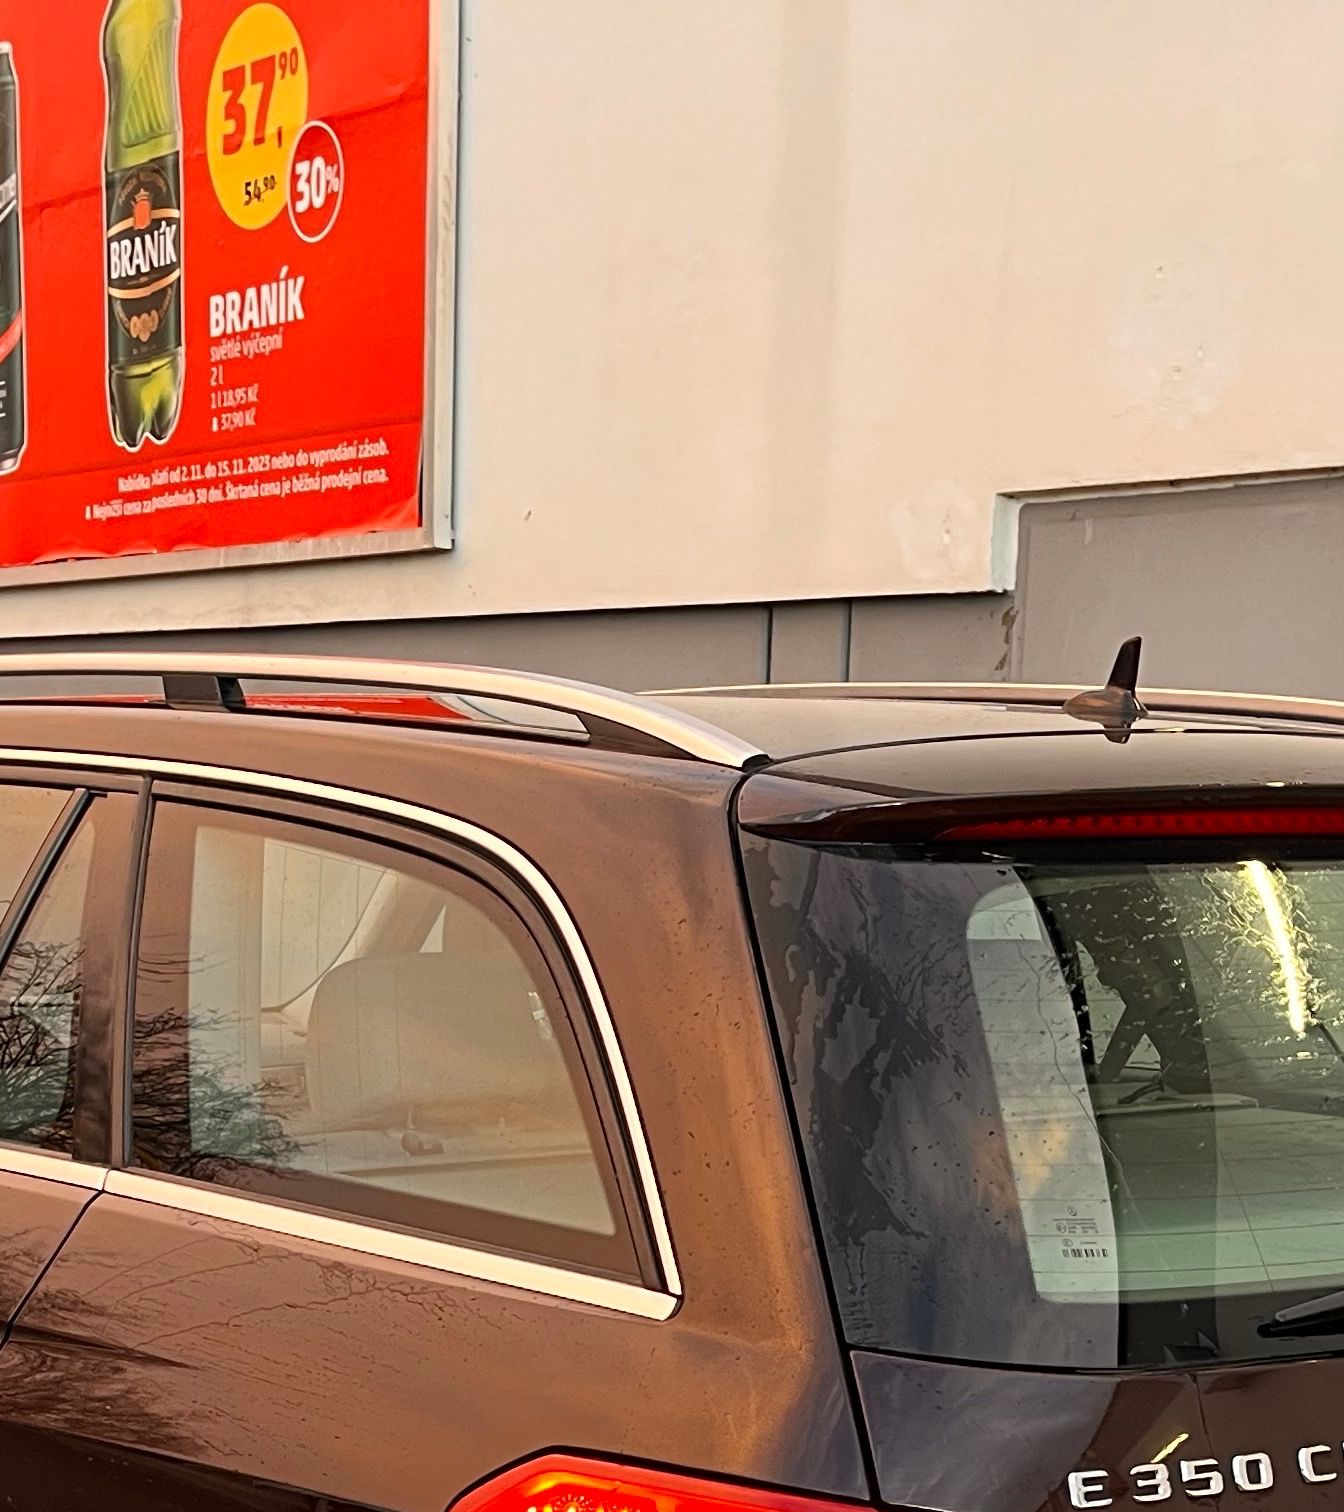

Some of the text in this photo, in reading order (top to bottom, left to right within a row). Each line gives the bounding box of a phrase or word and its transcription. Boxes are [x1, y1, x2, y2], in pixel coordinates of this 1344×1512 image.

[295, 156, 340, 213] 30%
[110, 220, 178, 280] BRANÍK
[209, 265, 305, 338] BRANÍK
[210, 366, 218, 386] 2
[1067, 1469, 1113, 1509] E
[1129, 1452, 1275, 1503] 350
